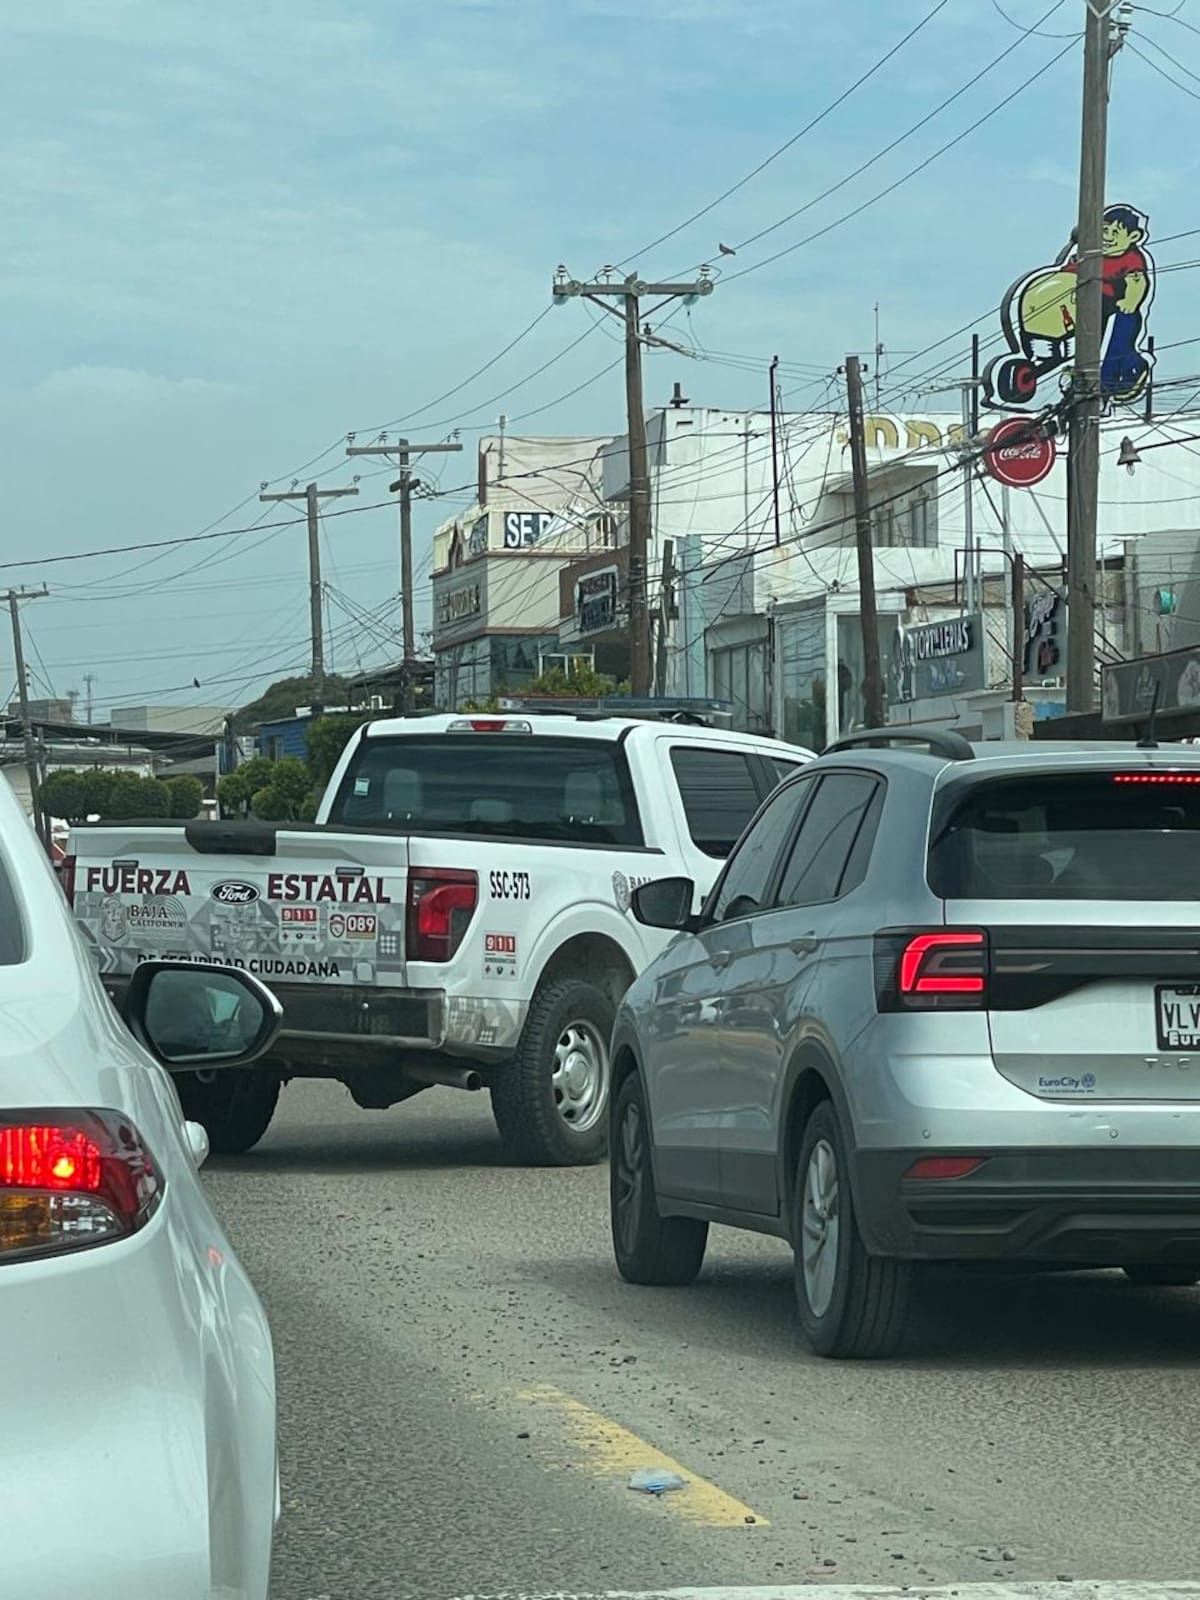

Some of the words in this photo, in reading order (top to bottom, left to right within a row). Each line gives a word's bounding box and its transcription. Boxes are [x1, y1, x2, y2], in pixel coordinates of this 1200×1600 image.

[87, 867, 191, 895] FUERZA
[268, 873, 391, 903] ESTATAL
[218, 883, 251, 902] Ford
[130, 905, 168, 918] BAJA
[282, 909, 316, 921] 911
[347, 915, 376, 932] 089
[486, 936, 515, 951] 911
[249, 958, 340, 977] CIUDADANA
[1038, 1076, 1081, 1089] EuroCity
